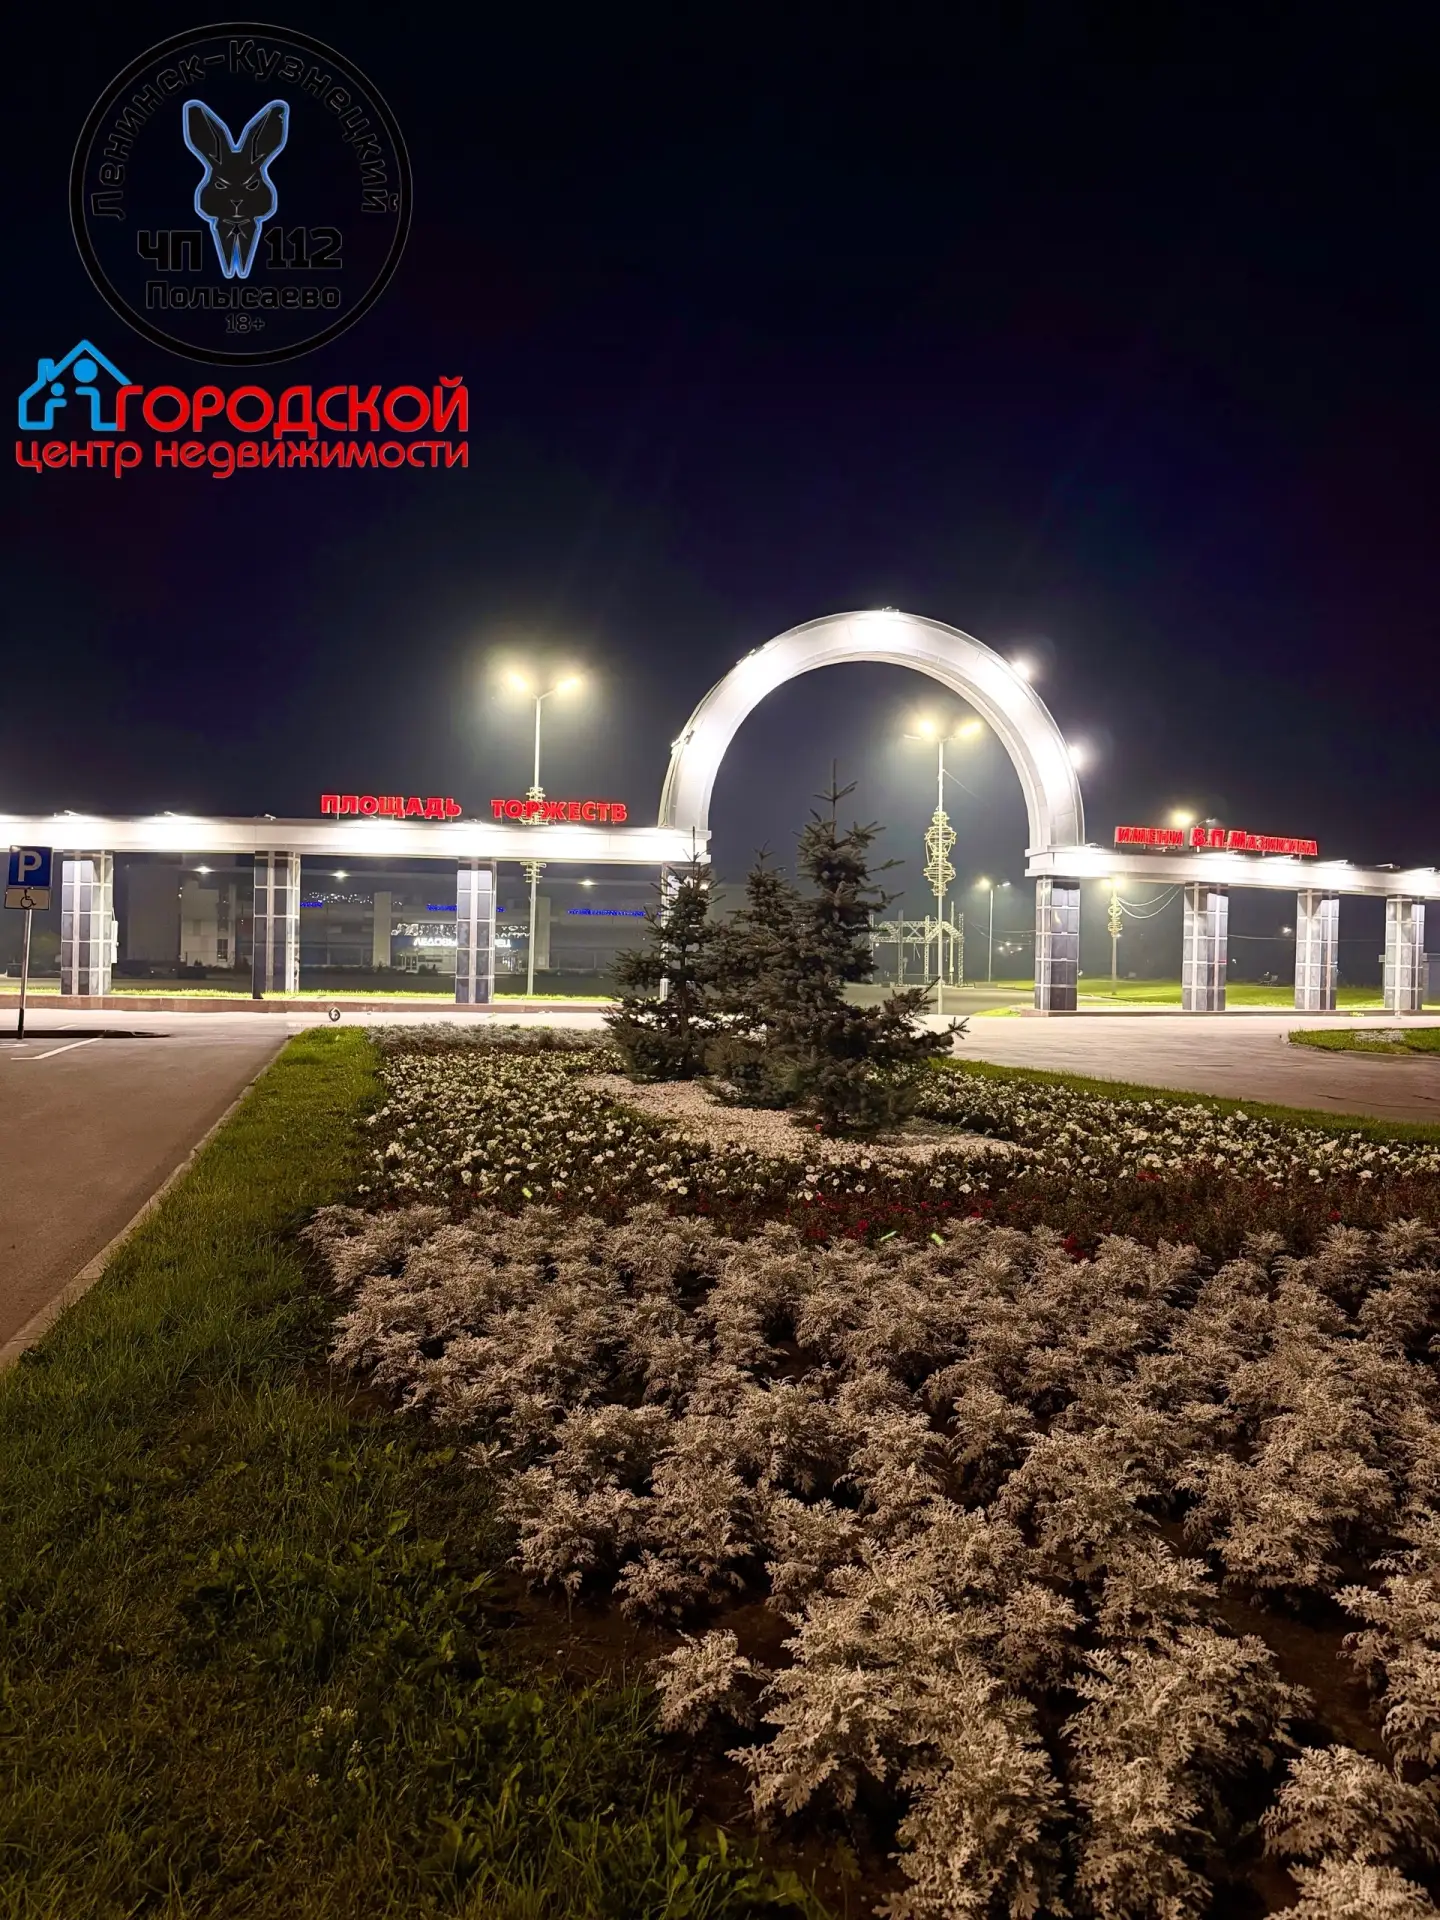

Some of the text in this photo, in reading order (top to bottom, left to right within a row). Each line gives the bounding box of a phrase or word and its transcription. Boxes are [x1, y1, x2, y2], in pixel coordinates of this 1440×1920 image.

[320, 794, 628, 823] ПЛОЩАДЬ ТОРЖЕСТВ
[1114, 826, 1185, 847] ИМЕНИ
[18, 851, 43, 882] P
